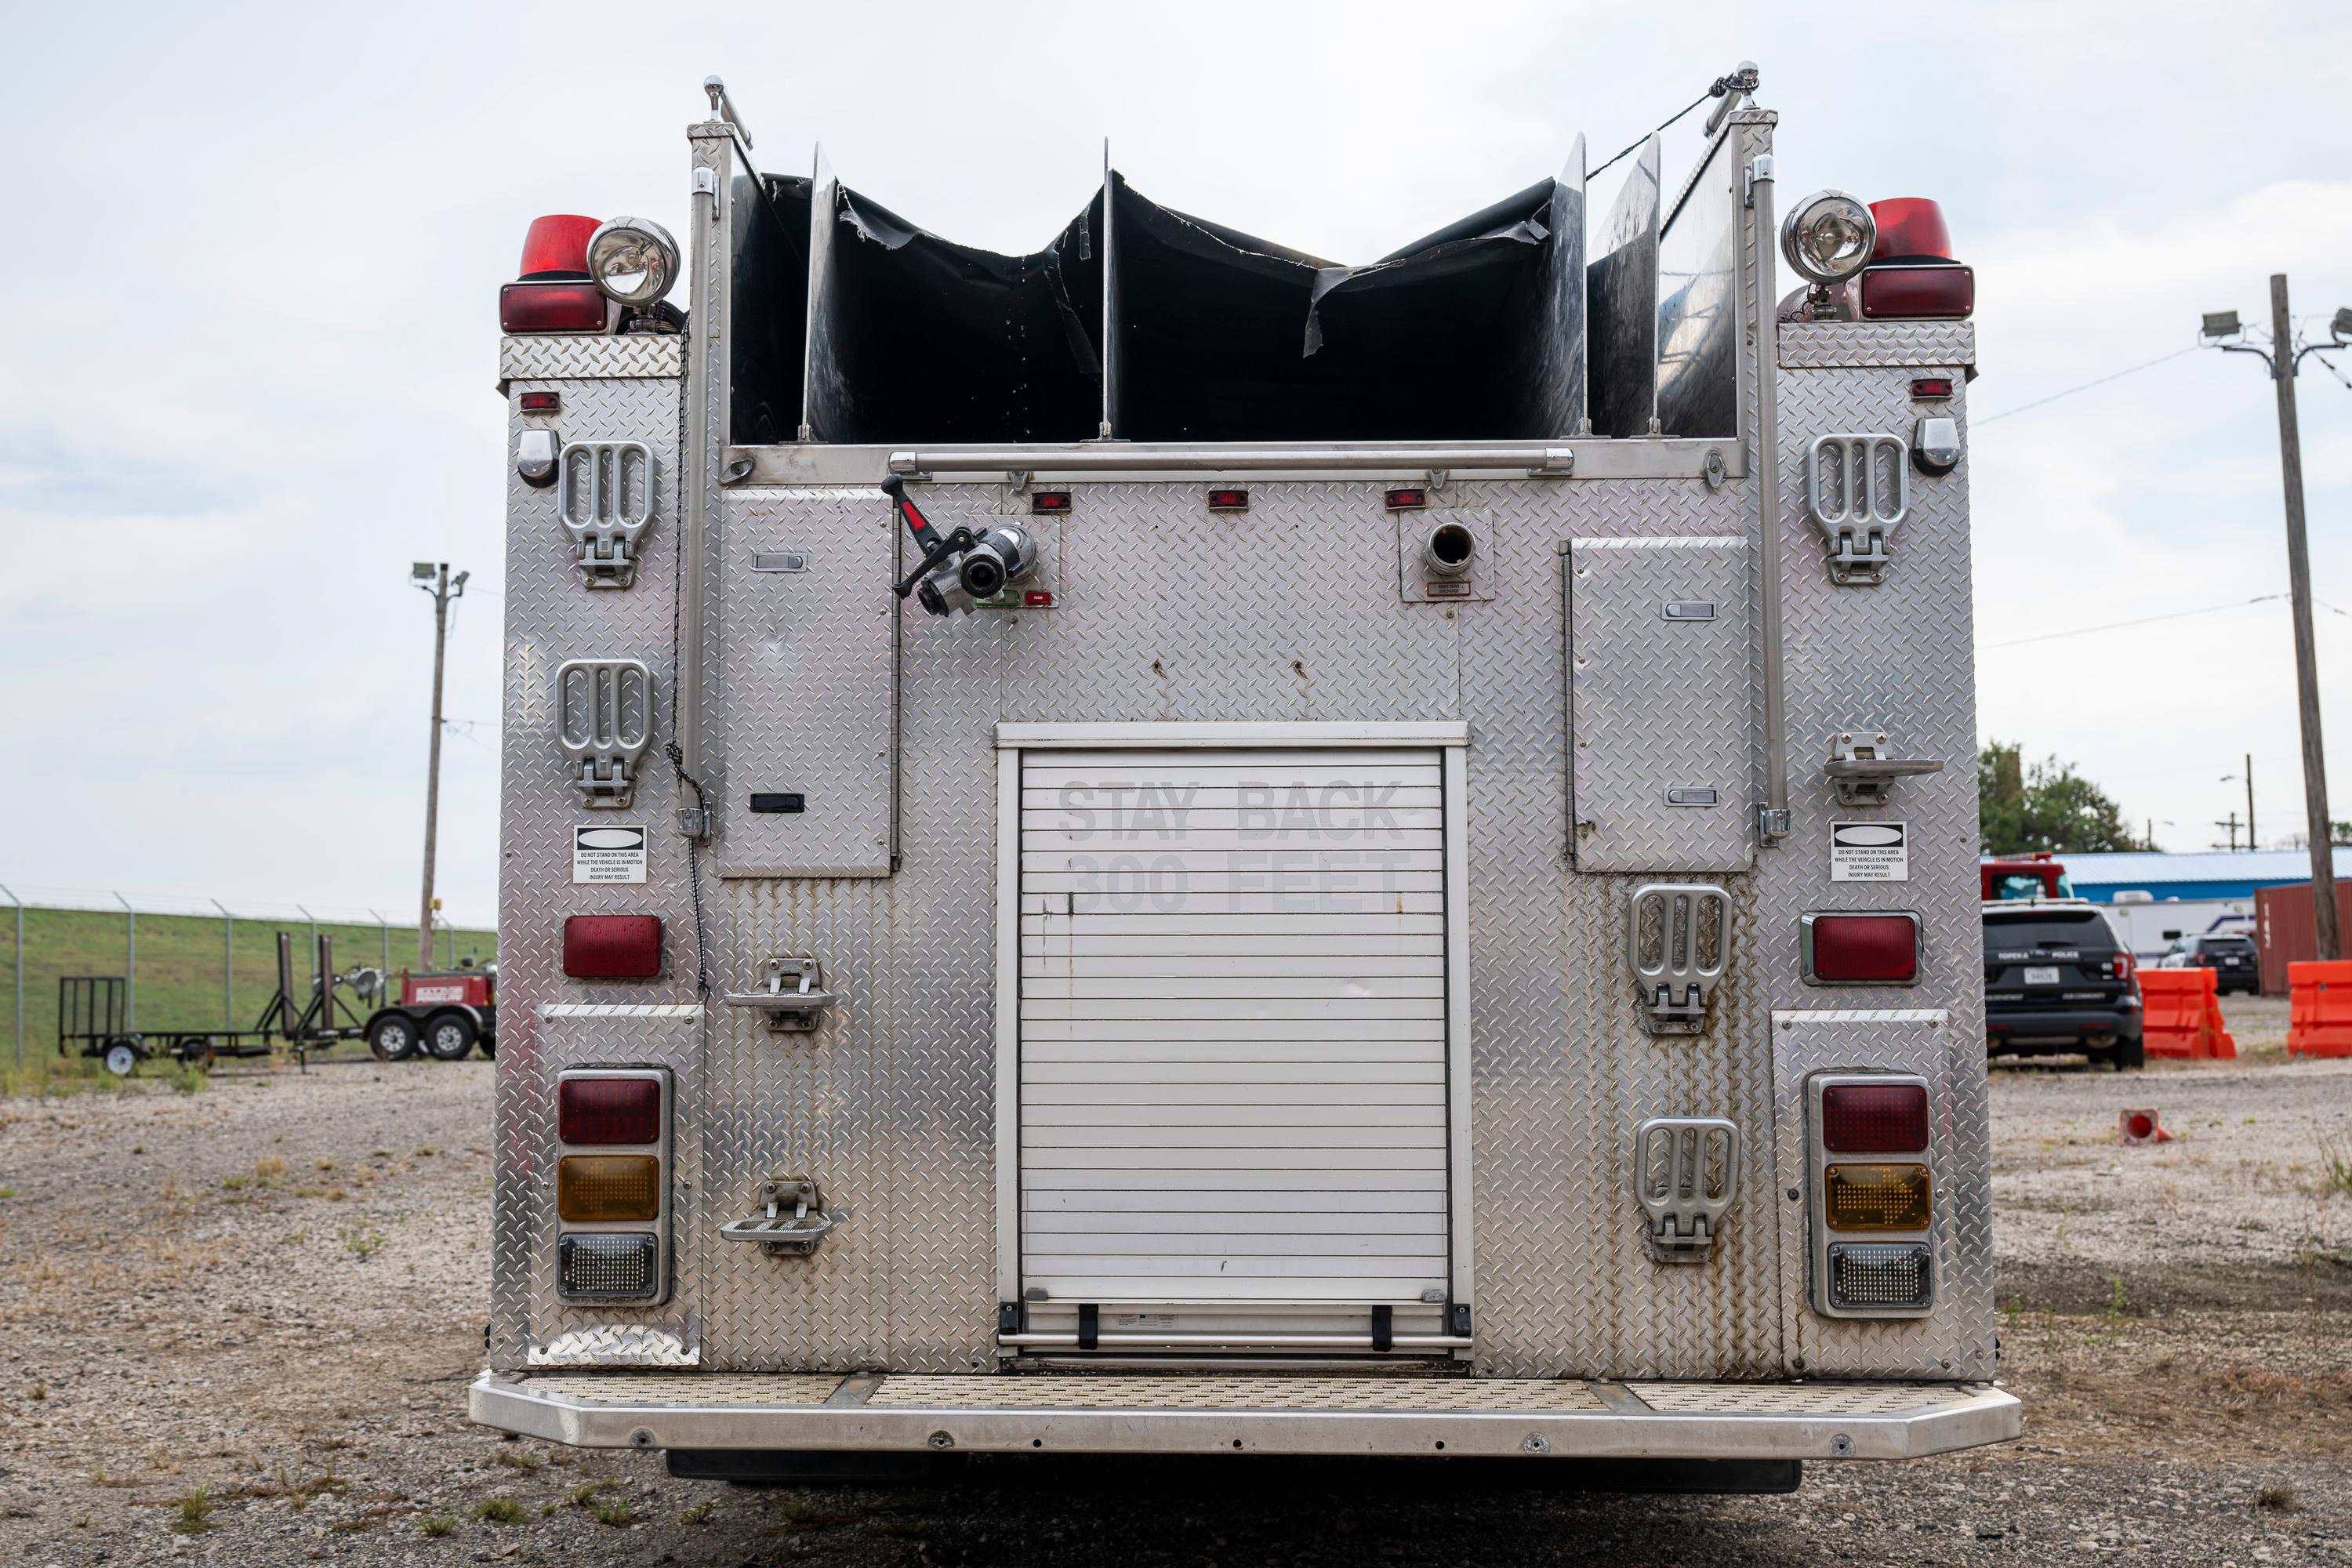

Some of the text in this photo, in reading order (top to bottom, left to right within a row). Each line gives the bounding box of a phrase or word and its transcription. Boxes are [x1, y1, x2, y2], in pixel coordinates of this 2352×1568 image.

[1058, 780, 1405, 842] STAY BACK
[1064, 851, 1411, 913] 300 FEET
